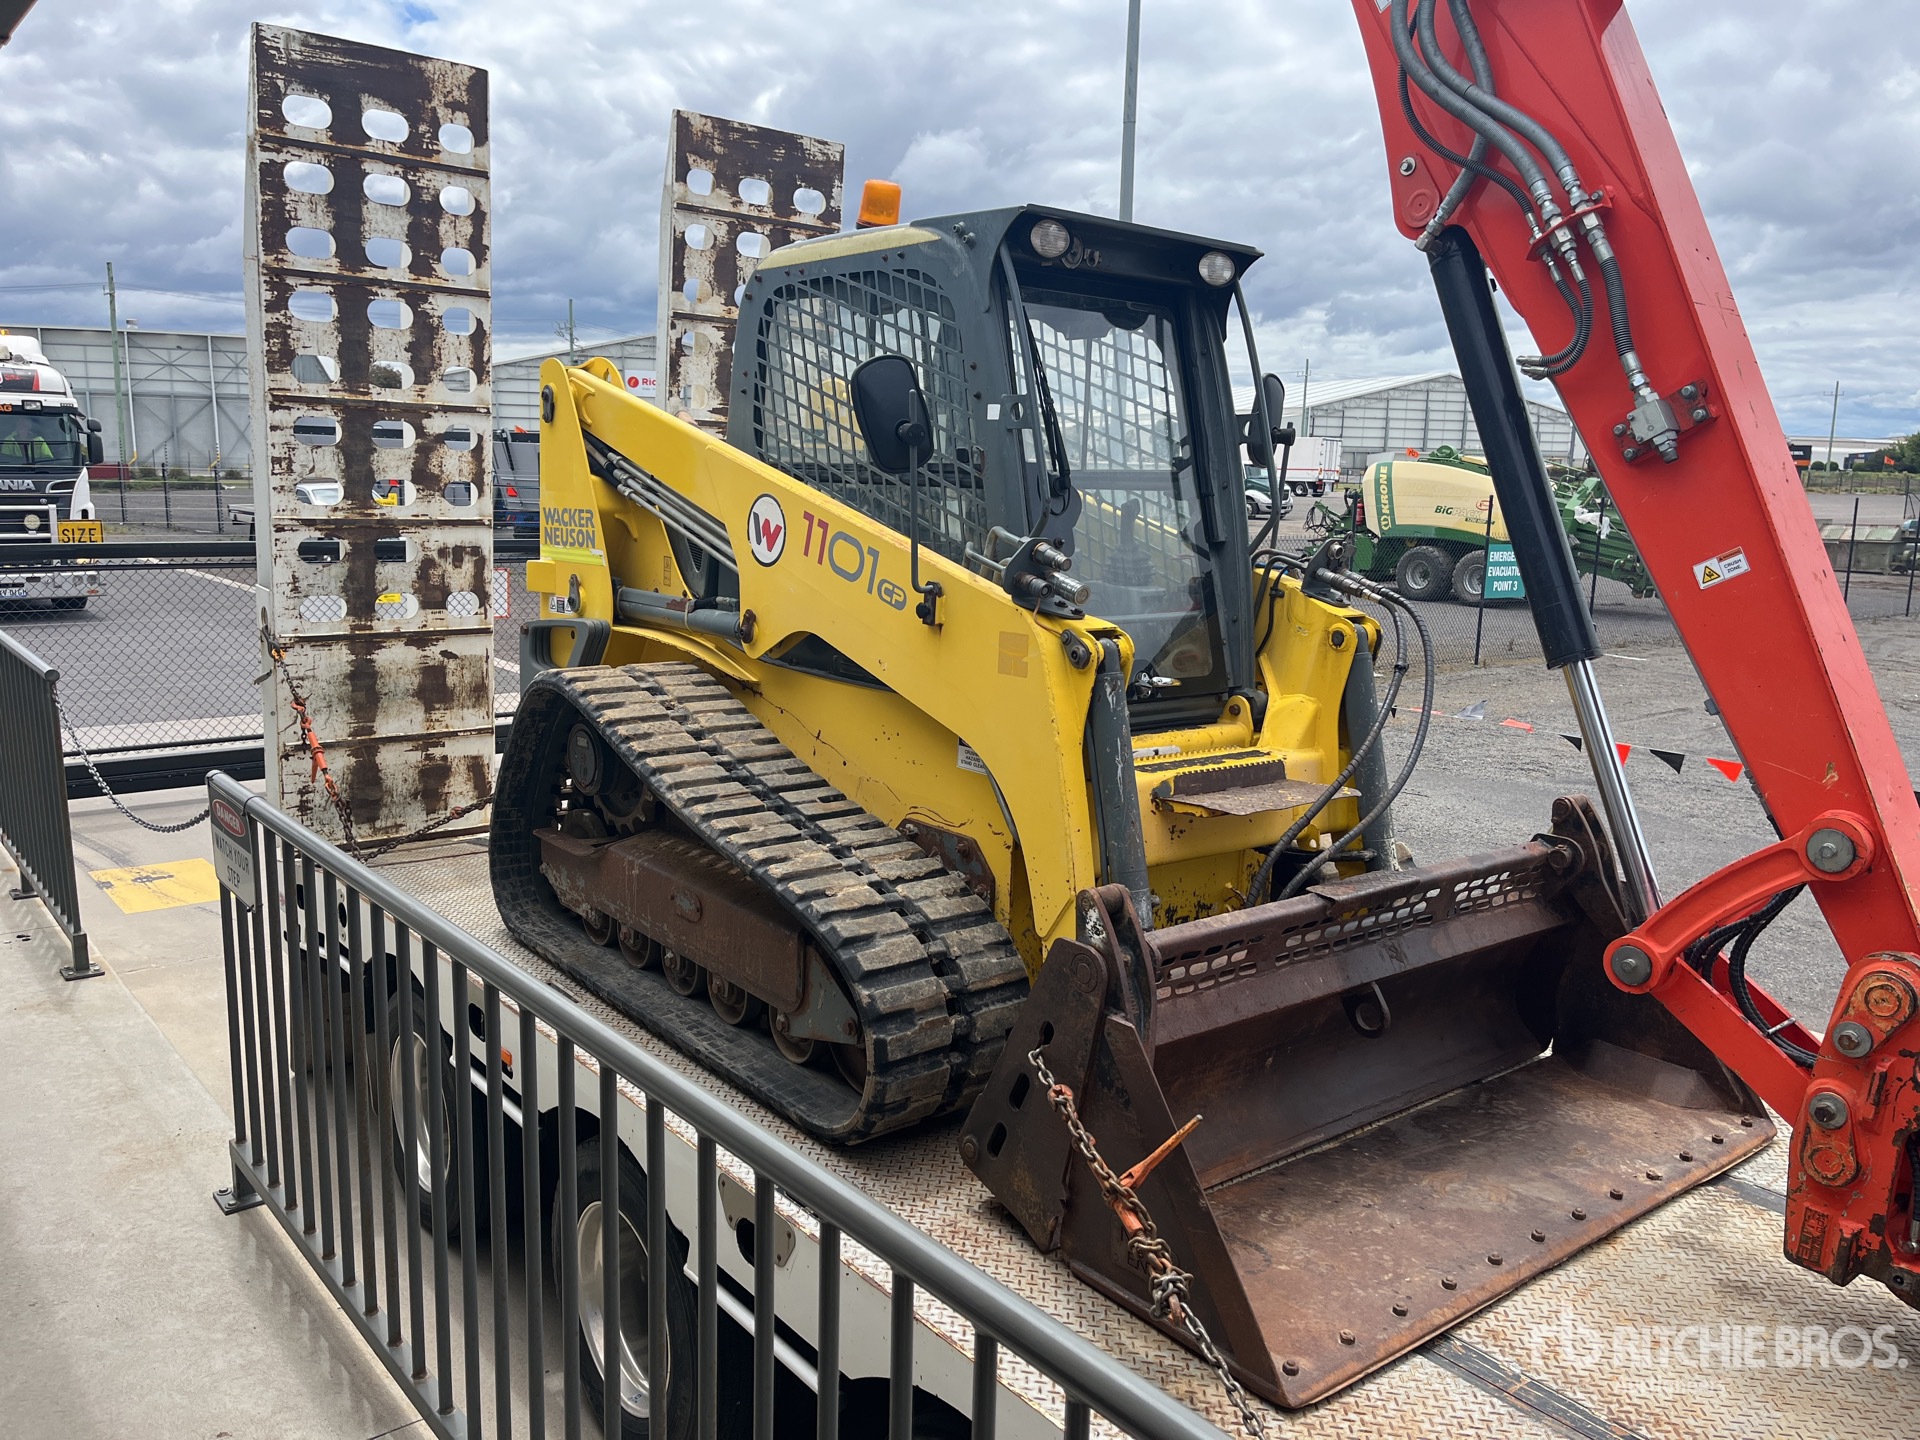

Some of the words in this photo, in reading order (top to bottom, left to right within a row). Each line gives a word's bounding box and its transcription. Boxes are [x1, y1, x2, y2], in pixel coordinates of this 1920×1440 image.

[1380, 465, 1390, 514] KRONE
[543, 507, 595, 528] WACKER
[61, 527, 98, 543] SIZE
[544, 527, 596, 549] NEUSON
[803, 510, 880, 595] 1101
[1723, 558, 1742, 569] CRUSH
[1493, 580, 1512, 591] POINT
[1513, 580, 1518, 591] 3
[216, 803, 241, 834] DANGER
[215, 832, 233, 861] WATCH
[233, 850, 250, 875] YOUR
[227, 865, 240, 887] STEP
